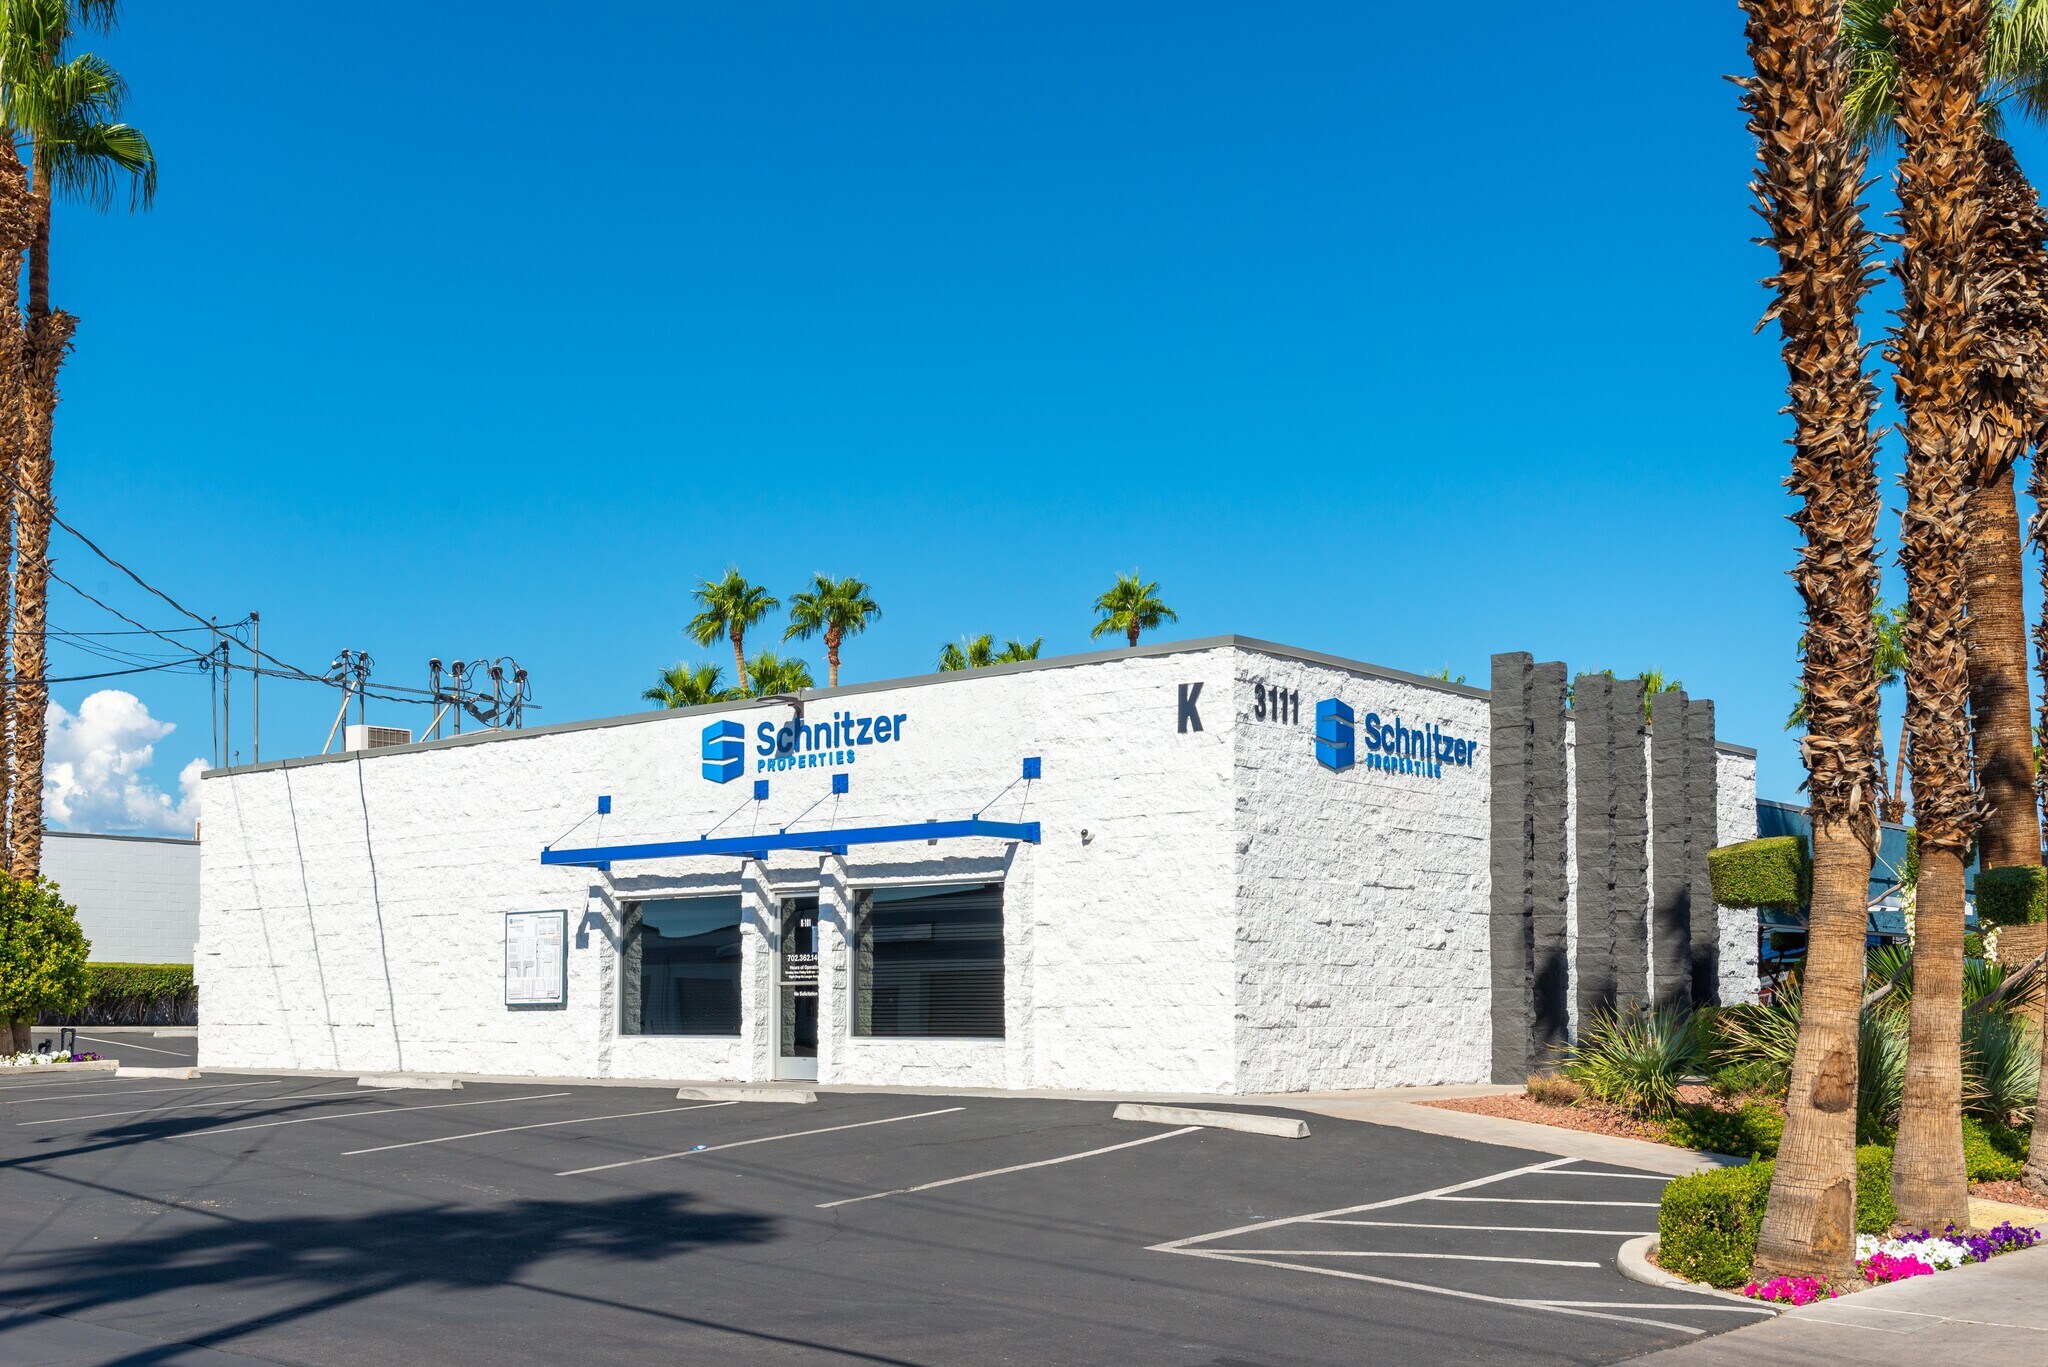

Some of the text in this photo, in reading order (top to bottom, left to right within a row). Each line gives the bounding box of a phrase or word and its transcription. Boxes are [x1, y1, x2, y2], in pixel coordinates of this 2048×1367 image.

[1177, 682, 1204, 734] K
[1254, 683, 1299, 725] 3111
[756, 711, 907, 757] Schnitzer
[1364, 712, 1478, 769] Schnitzer
[757, 749, 856, 774] PROPERTIES
[1366, 752, 1442, 780] PROPERTIES
[787, 954, 818, 962] 702.362.14
